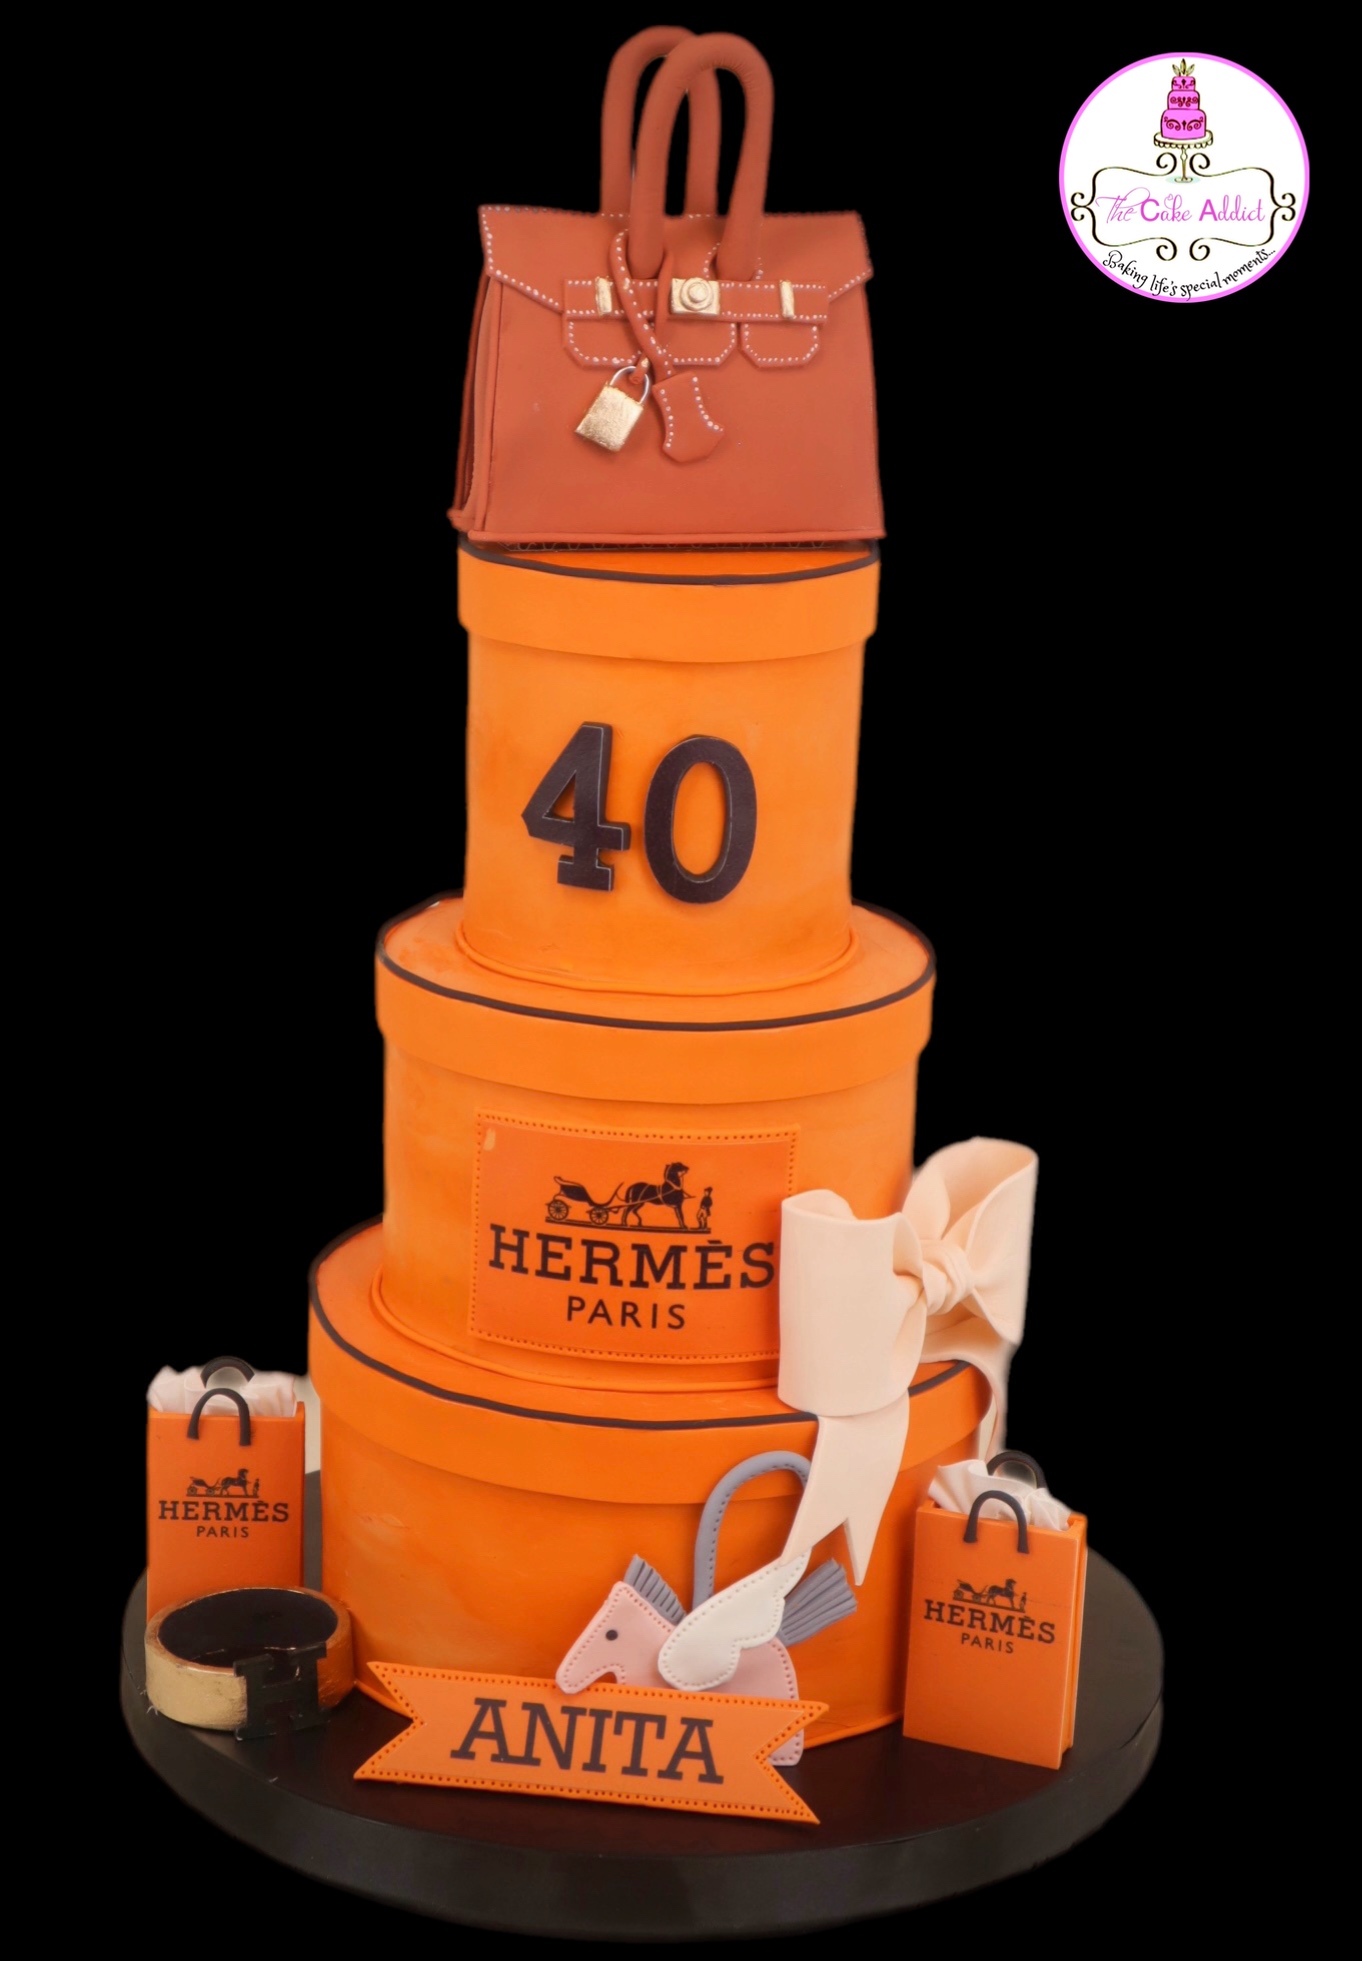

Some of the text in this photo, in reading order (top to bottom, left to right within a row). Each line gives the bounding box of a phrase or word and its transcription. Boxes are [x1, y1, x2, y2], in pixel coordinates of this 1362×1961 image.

[521, 721, 757, 905] 40
[488, 1223, 776, 1290] HERMÈS
[567, 1295, 686, 1330] PARIS
[196, 1525, 249, 1538] PARIS
[961, 1632, 1014, 1654] PARIS
[450, 1697, 724, 1785] ANITA
